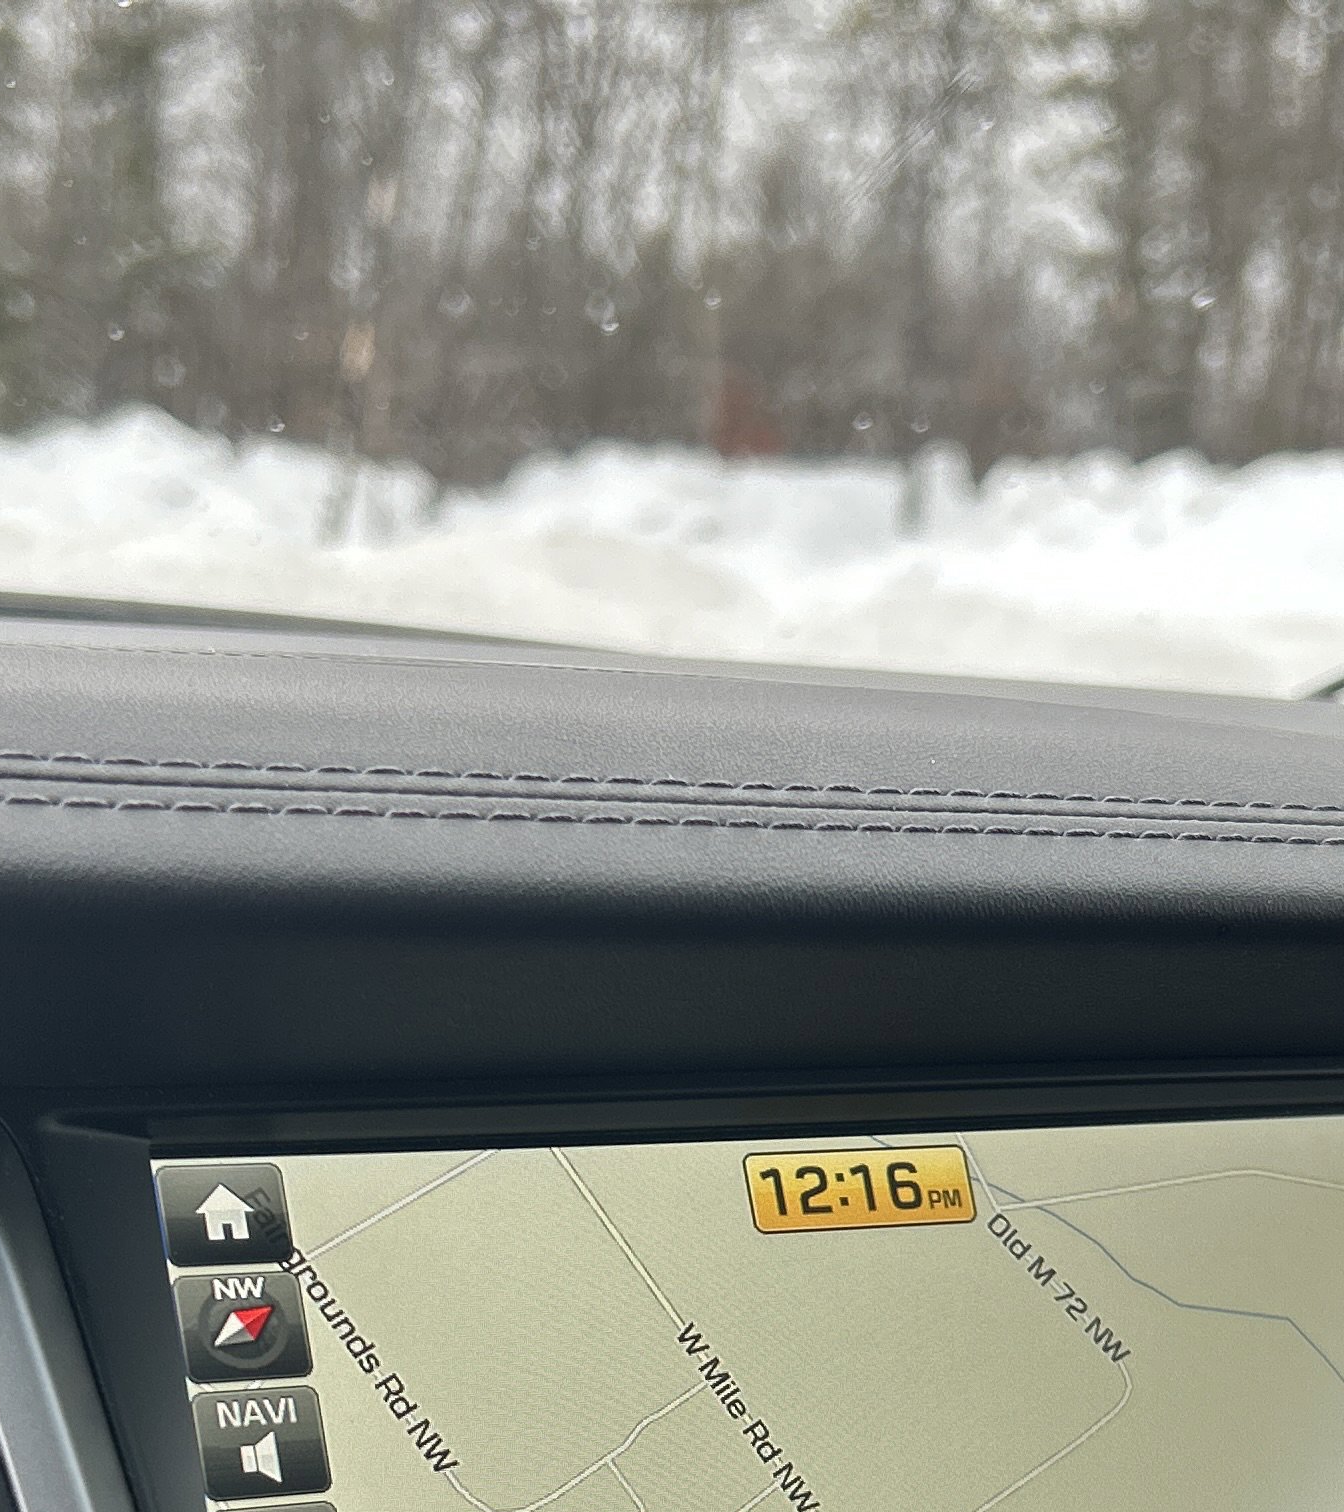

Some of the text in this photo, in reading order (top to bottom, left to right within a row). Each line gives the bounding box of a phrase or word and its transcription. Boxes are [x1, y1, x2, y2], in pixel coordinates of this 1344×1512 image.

[759, 1161, 963, 1216] 12:16 PM
[211, 1276, 265, 1301] NW
[987, 1213, 1132, 1363] Old M 72 NW
[215, 1396, 298, 1429] NAVI
[374, 1373, 418, 1420] Rd
[406, 1418, 460, 1472] NW
[677, 1321, 821, 1512] W Mile Rd NW
